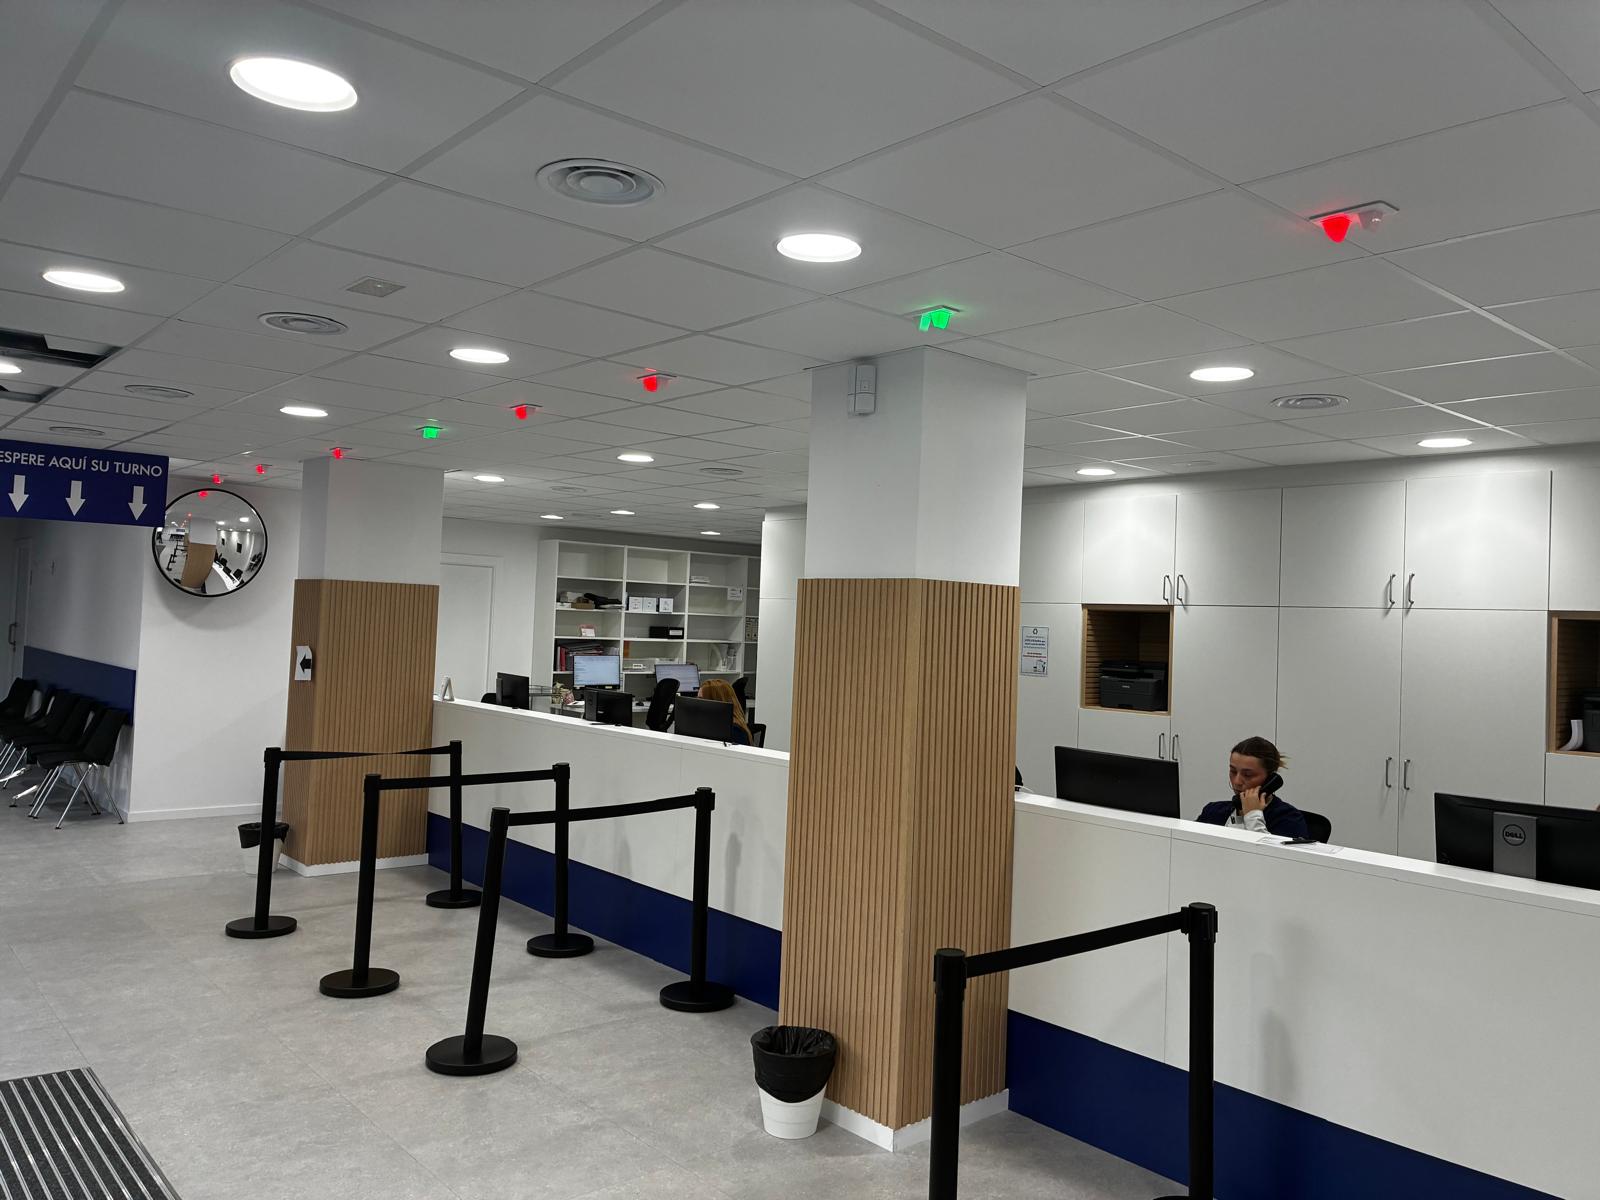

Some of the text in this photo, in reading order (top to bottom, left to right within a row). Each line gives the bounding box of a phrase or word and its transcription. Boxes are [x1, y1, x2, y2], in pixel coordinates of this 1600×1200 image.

[48, 455, 88, 470] AQUÍ
[91, 459, 110, 472] SU
[113, 461, 163, 477] TURNO
[1505, 831, 1523, 839] DELL
